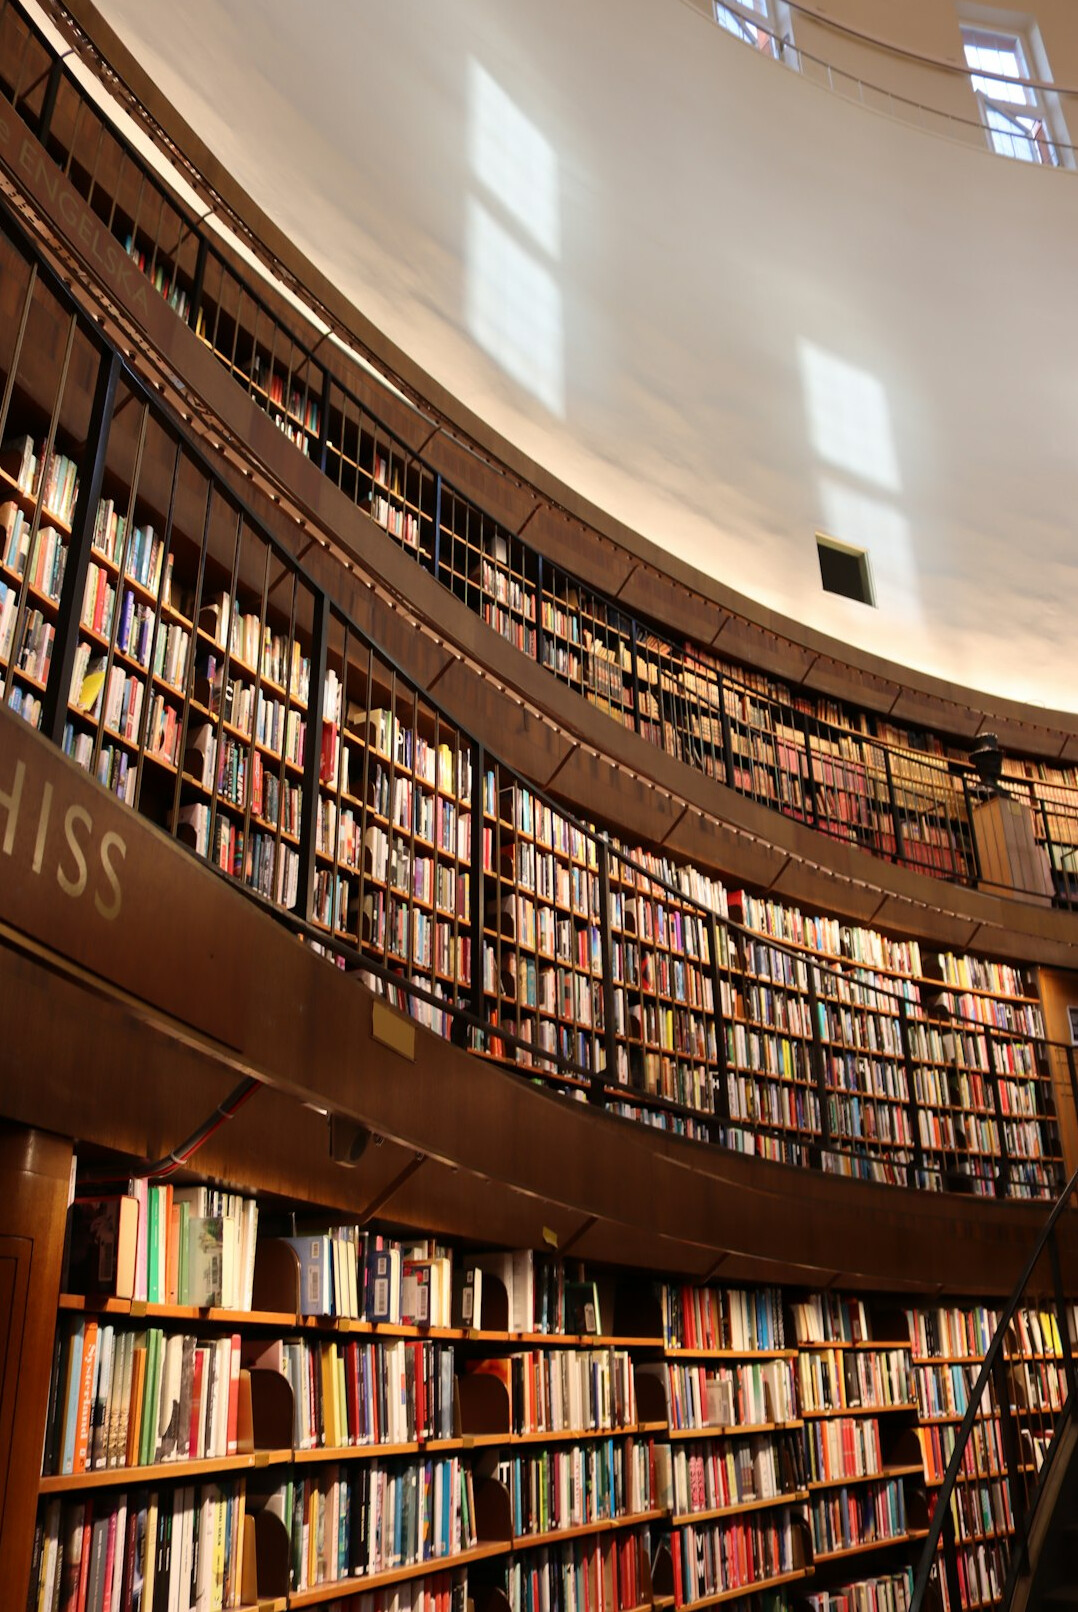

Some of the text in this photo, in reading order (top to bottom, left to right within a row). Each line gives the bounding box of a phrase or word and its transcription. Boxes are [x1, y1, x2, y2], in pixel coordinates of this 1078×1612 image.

[19, 139, 149, 317] ENGELSKA
[80, 1343, 97, 1440] Systerland
[500, 1461, 510, 1485] T
